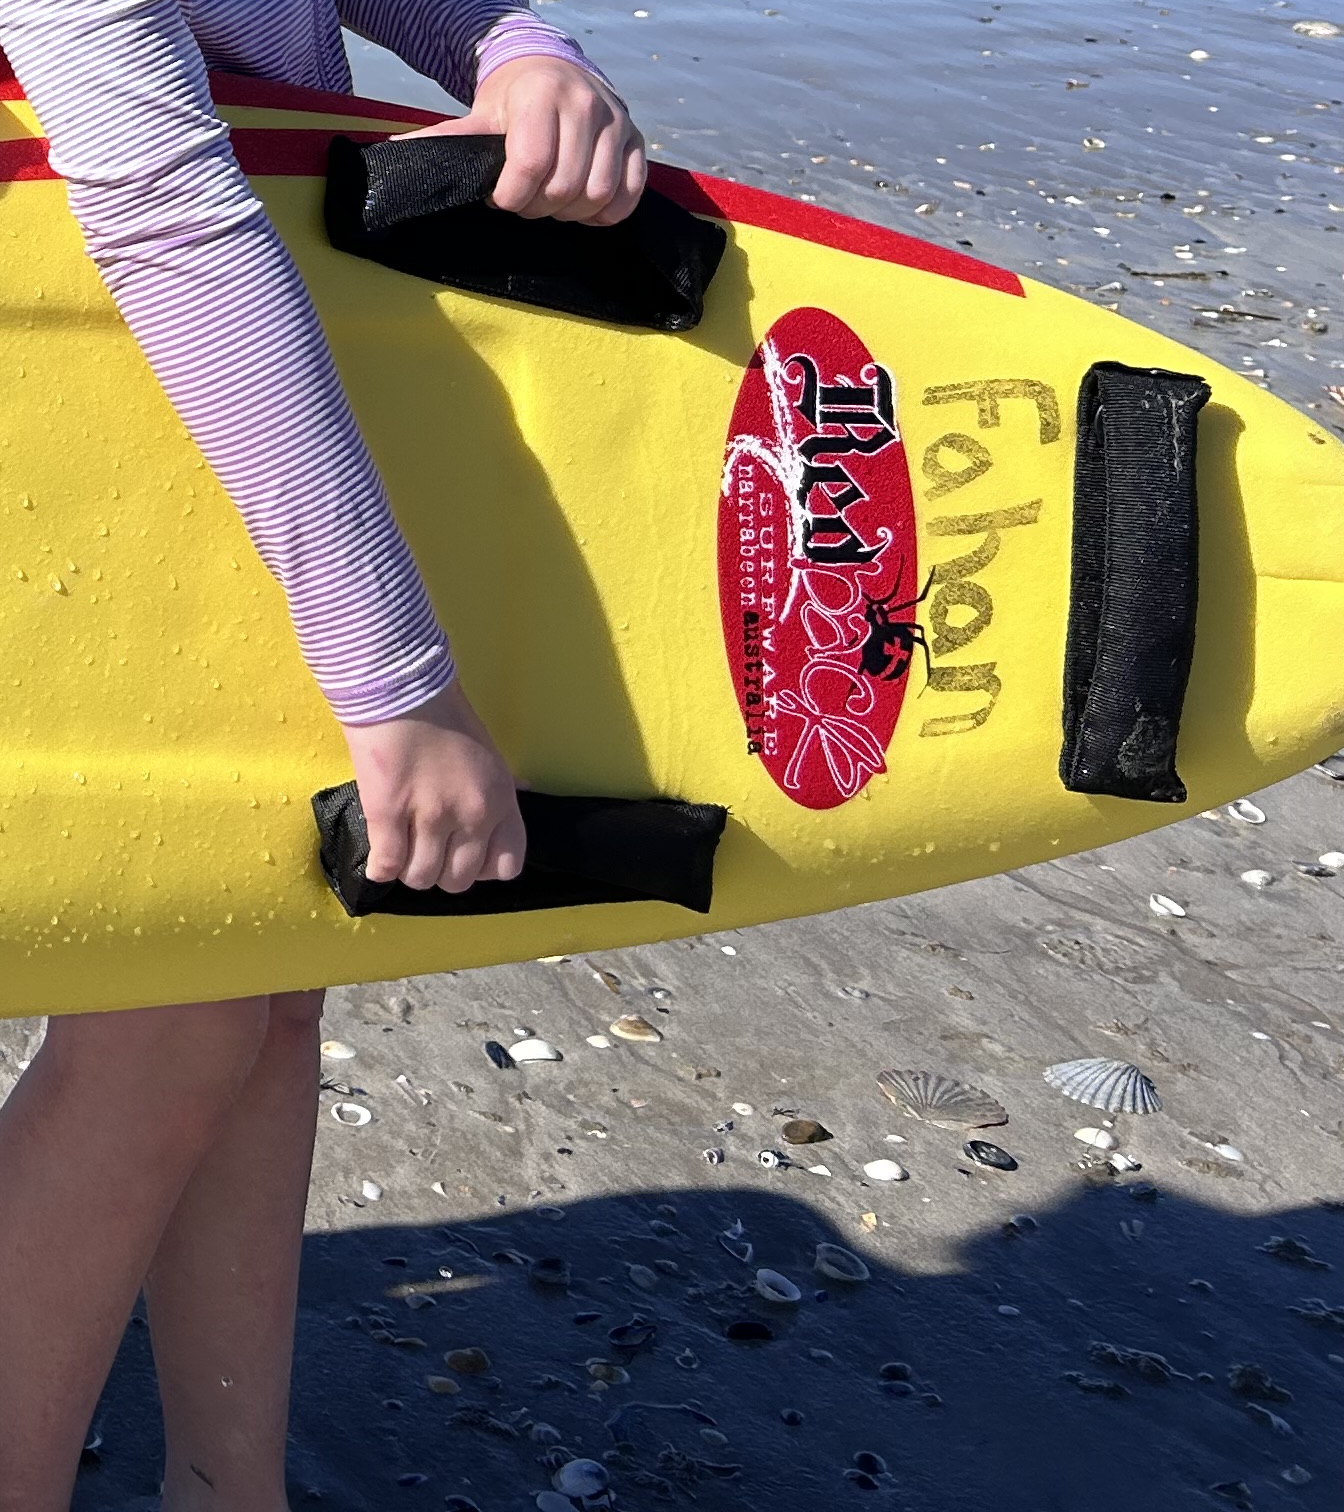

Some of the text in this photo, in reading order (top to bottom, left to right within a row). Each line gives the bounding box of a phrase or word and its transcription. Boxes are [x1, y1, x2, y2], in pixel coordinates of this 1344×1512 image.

[743, 610, 767, 756] australia
[759, 492, 778, 756] SURFWARE
[919, 377, 1061, 738] Fahan
